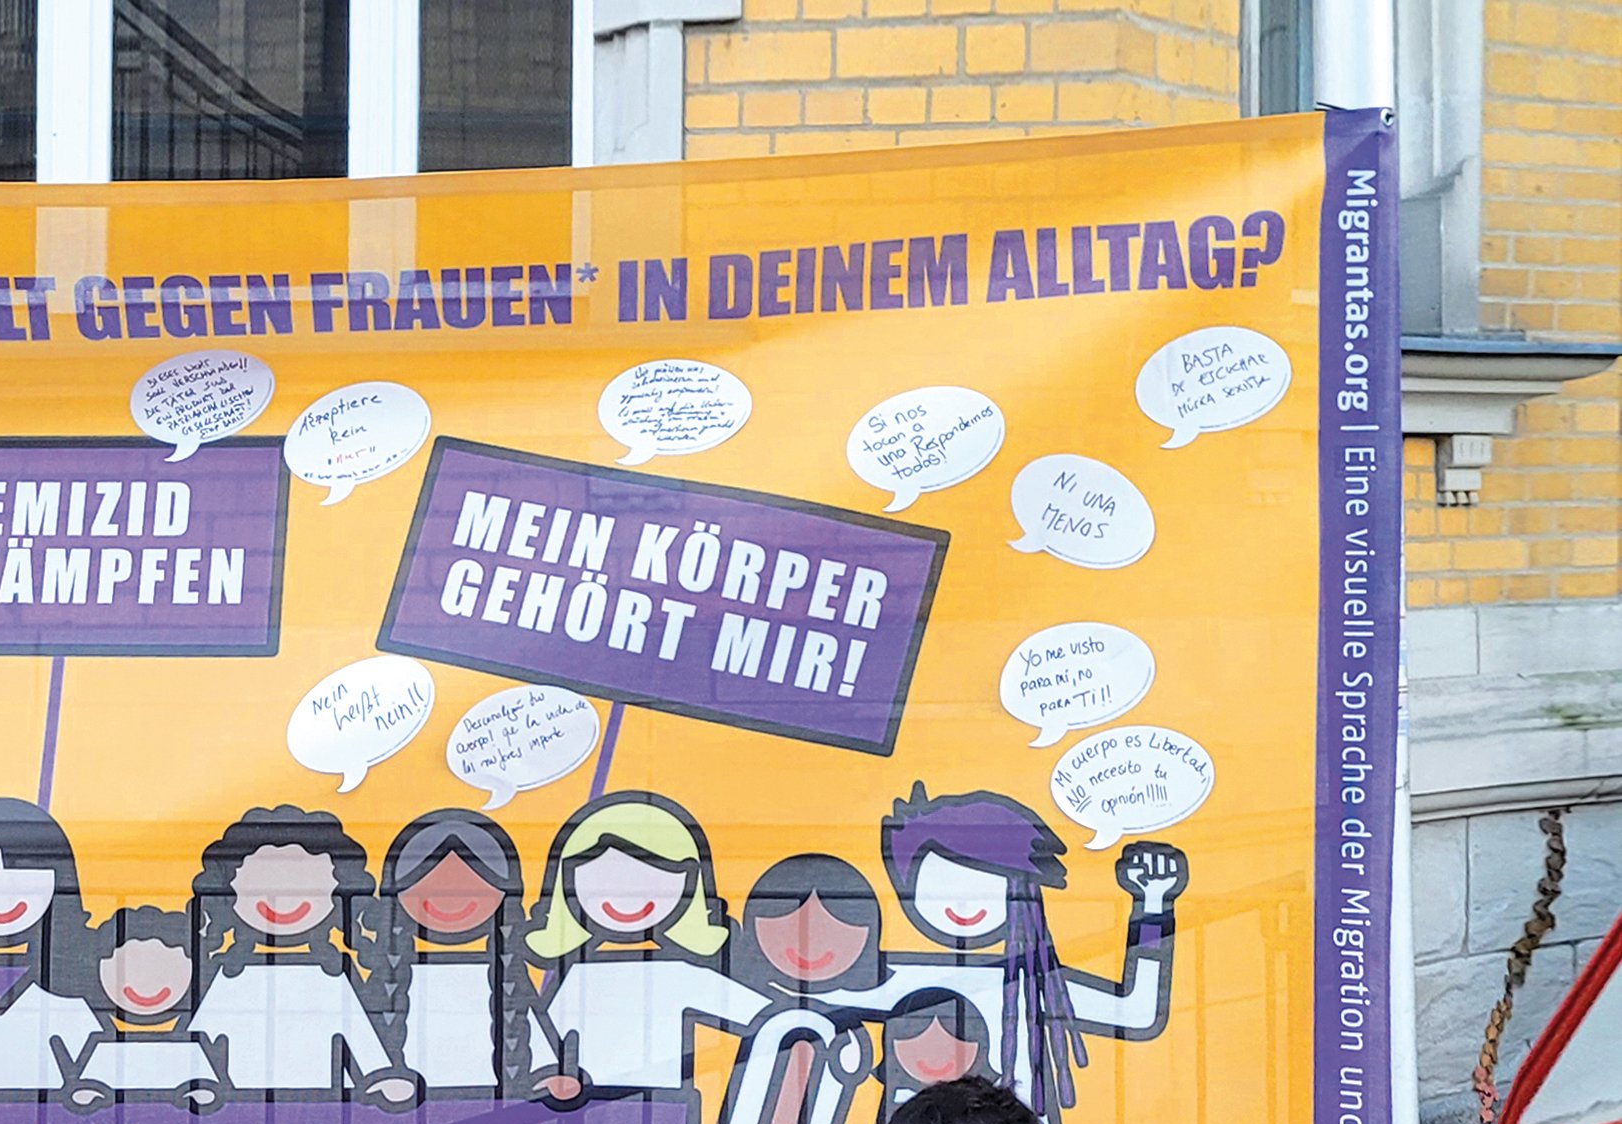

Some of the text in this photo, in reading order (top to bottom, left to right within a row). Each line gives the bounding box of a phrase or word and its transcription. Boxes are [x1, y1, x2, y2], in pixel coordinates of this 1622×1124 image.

[73, 274, 292, 340] GEGEN
[618, 258, 687, 322] IN
[708, 233, 968, 320] DEINEM
[986, 210, 1286, 303] ALLTAG?
[1337, 169, 1378, 413] Migrantas.org
[1181, 343, 1233, 374] BASTA
[862, 431, 907, 453] tocan
[868, 404, 927, 433] Si nos
[877, 405, 994, 466] una Respondemos
[1082, 491, 1116, 517] UNA
[1345, 447, 1376, 516] Eine
[1042, 503, 1110, 539] MENOS
[452, 490, 889, 629] MEIN KÖRPER
[1343, 528, 1376, 658] visuelle
[439, 558, 868, 698] GEHÖRT MIR!
[1019, 649, 1042, 676] Yo
[334, 684, 380, 731] heißt
[1072, 738, 1118, 769] cuerpo
[1125, 734, 1142, 748] es
[1335, 671, 1373, 805] Sprache
[1089, 760, 1142, 786] necesito
[1154, 763, 1168, 780] tu
[1341, 818, 1372, 876] der
[1333, 888, 1371, 1051] Migration
